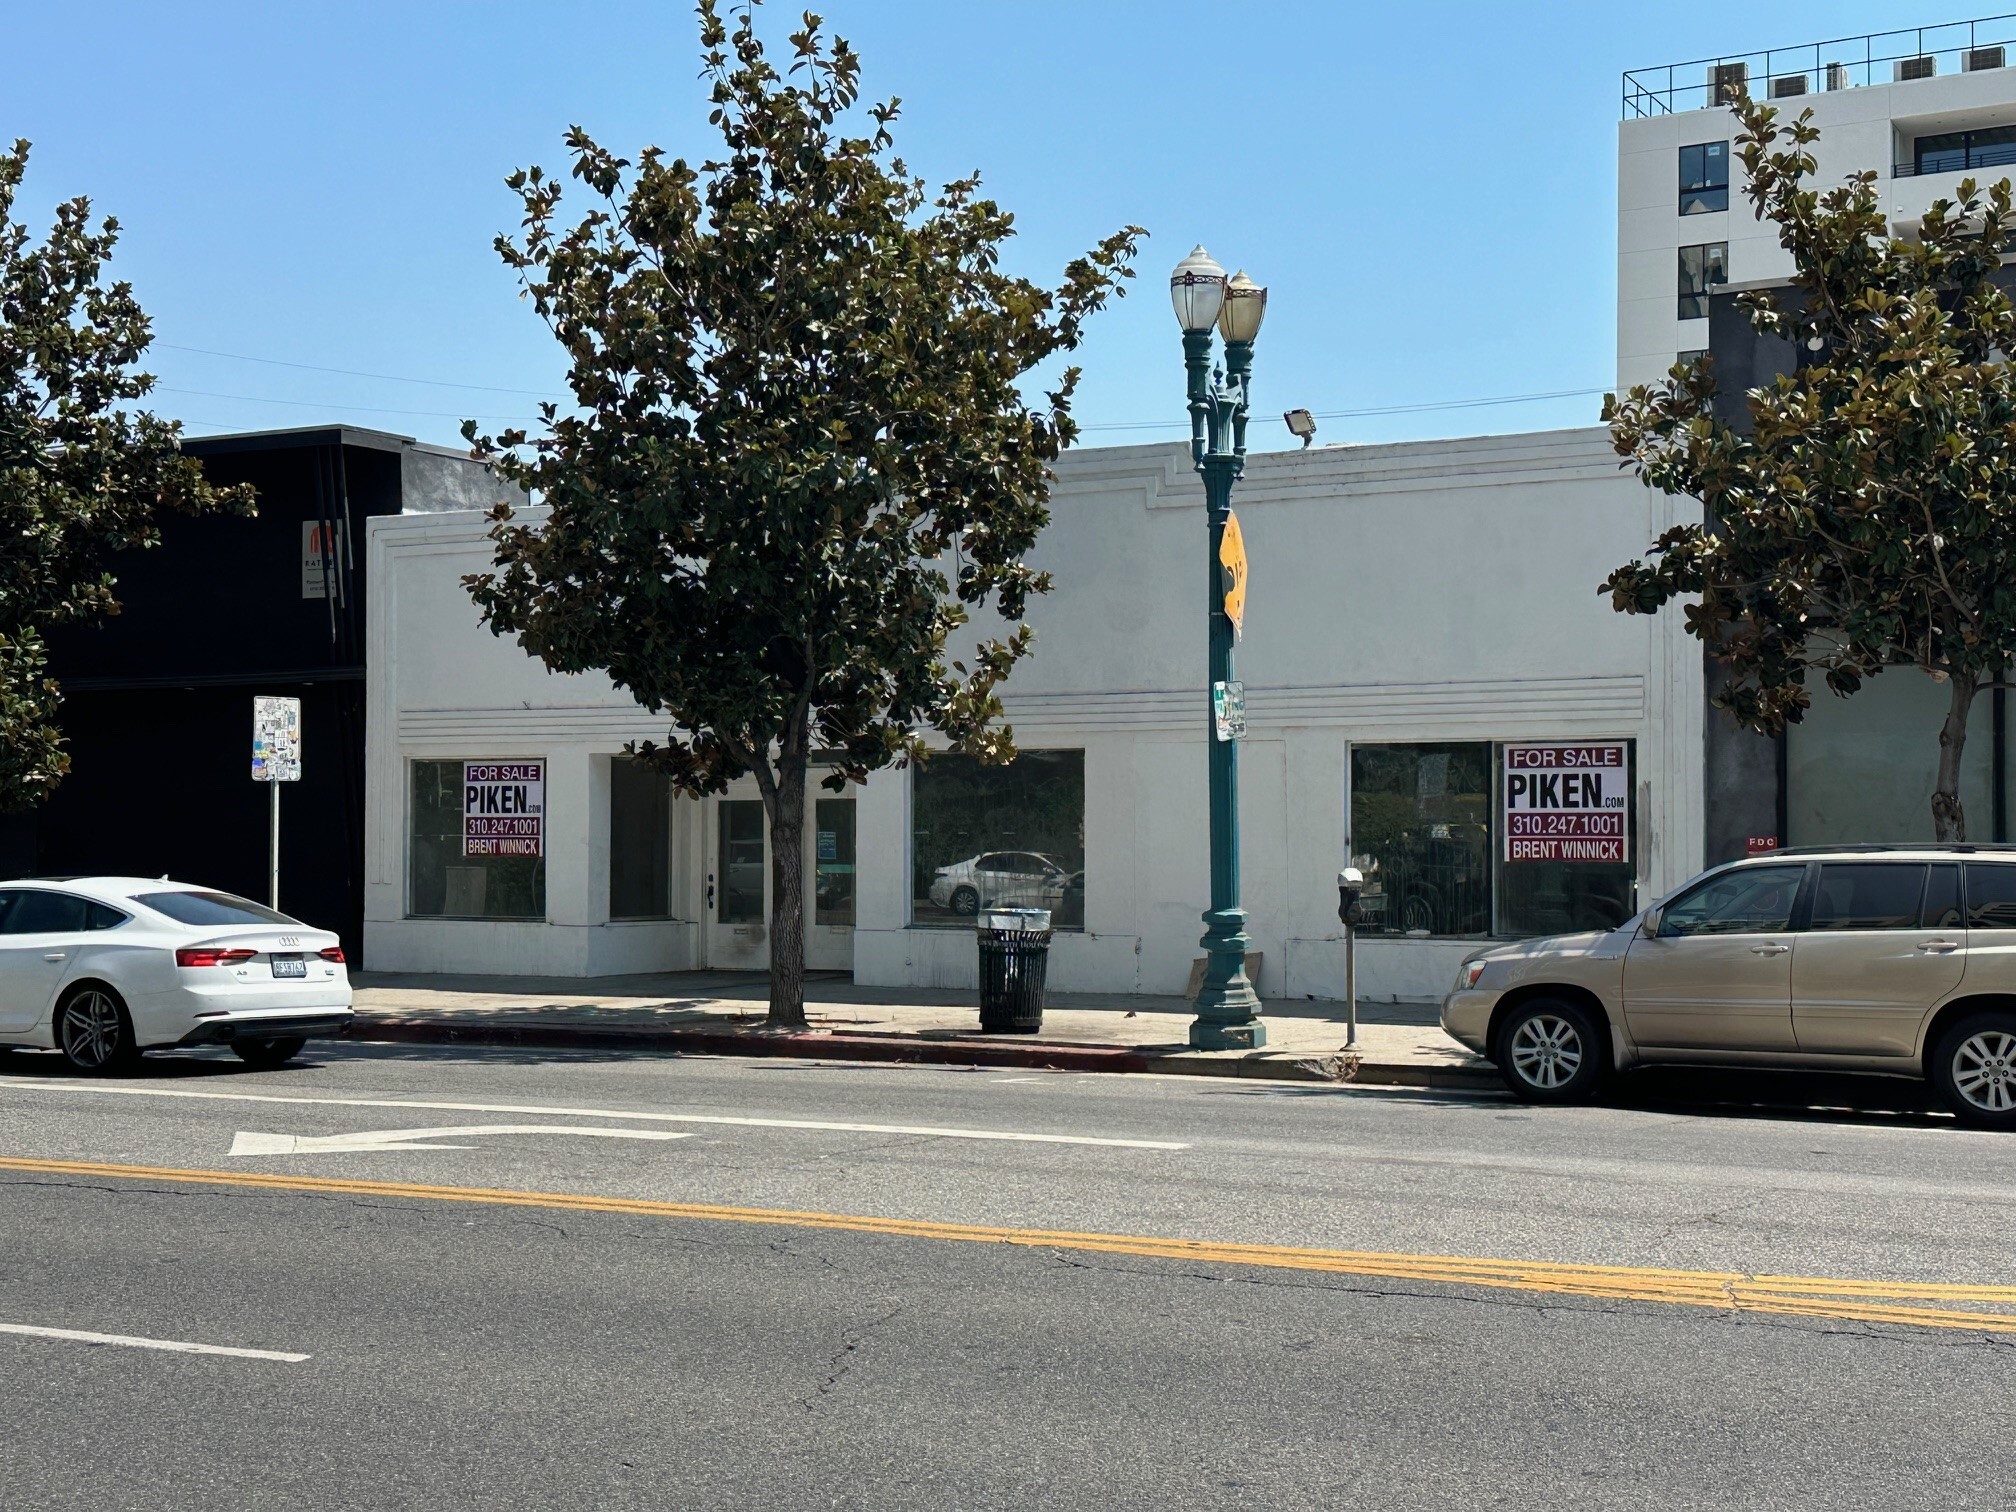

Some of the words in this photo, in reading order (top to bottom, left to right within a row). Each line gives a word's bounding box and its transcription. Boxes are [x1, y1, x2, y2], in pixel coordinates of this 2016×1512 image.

[1513, 750, 1556, 767] FOR
[1562, 749, 1617, 767] SALE
[469, 767, 498, 780] FOR
[501, 766, 537, 780] SALE
[469, 819, 537, 834] 310.247.1001
[1513, 815, 1619, 834] 310.247.1001
[468, 839, 498, 853] BRENT
[500, 839, 537, 854] WINNICK
[1513, 841, 1557, 859] BRENT
[1561, 841, 1619, 859] WINNICK
